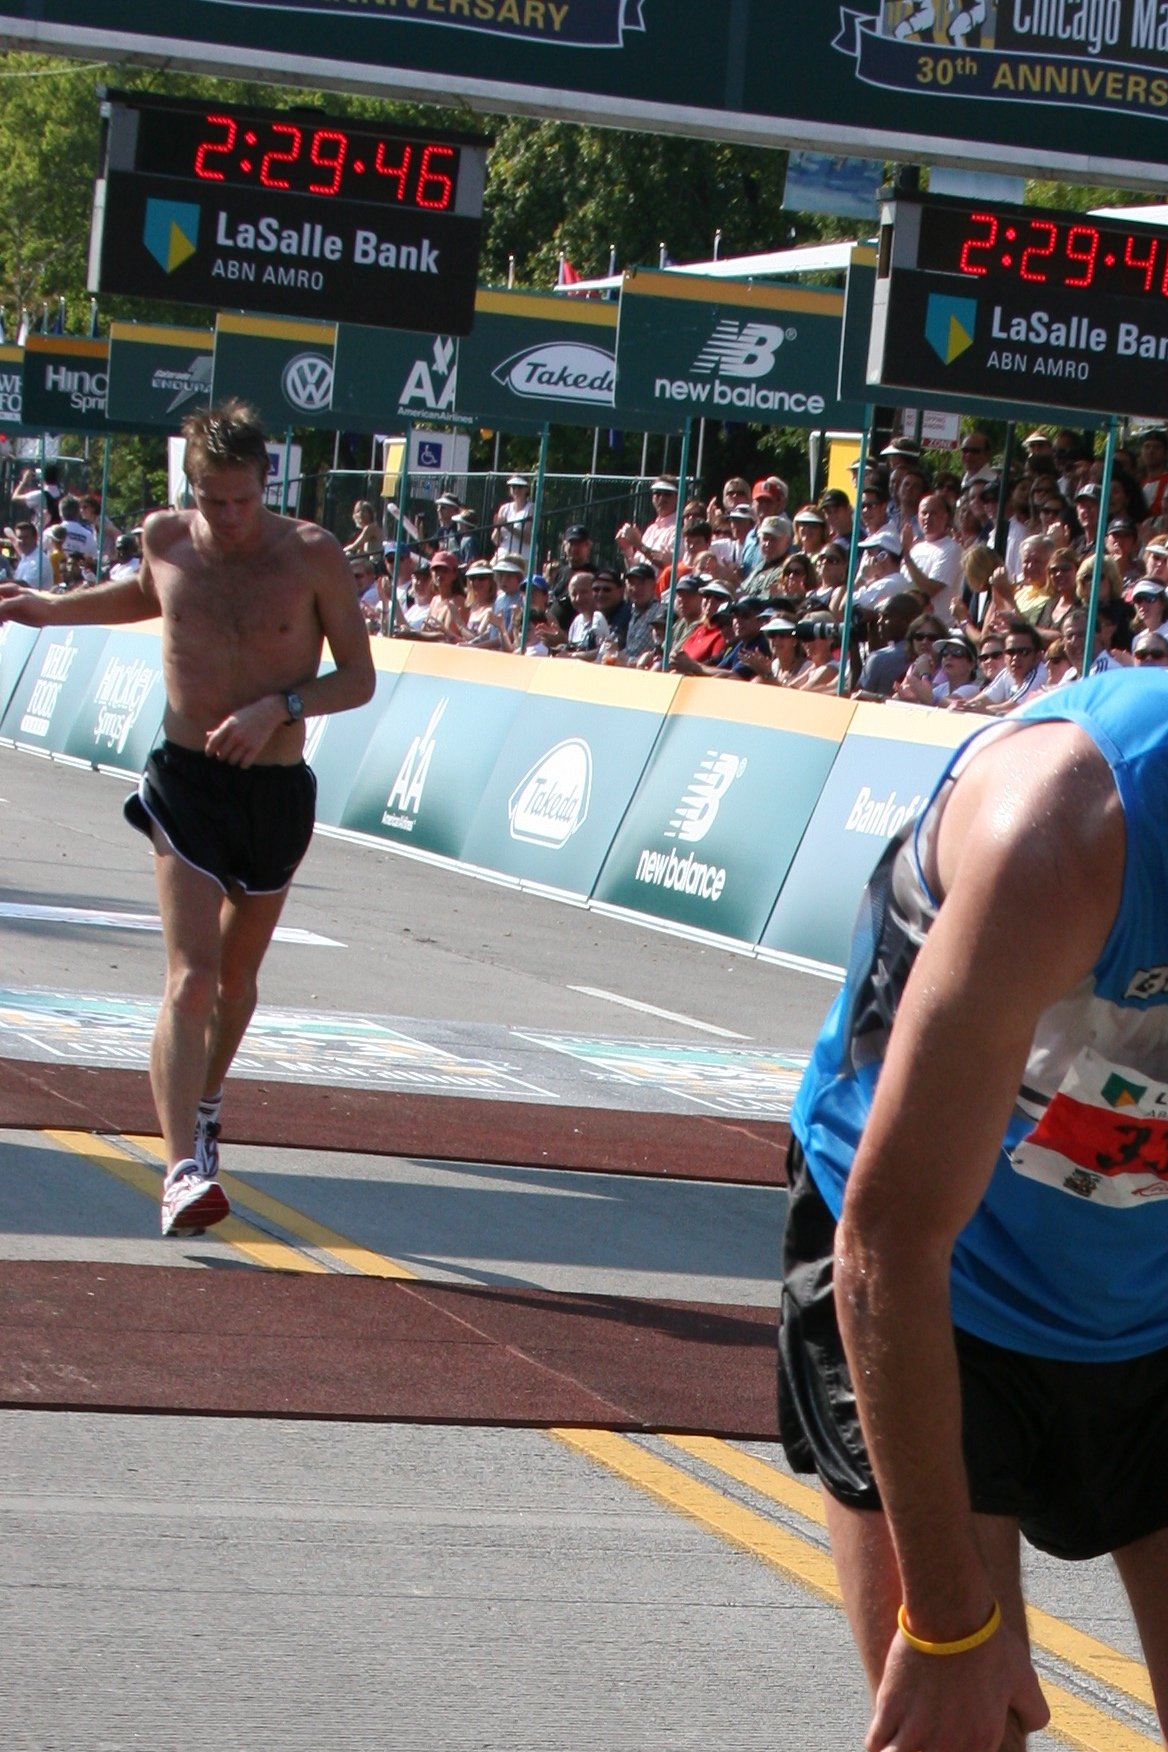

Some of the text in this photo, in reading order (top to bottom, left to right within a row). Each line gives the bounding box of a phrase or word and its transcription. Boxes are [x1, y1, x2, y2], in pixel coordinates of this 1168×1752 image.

[916, 55, 978, 86] 30th
[216, 210, 440, 275] LaSalle Bank
[211, 258, 324, 291] ABN AMRO
[991, 305, 1107, 352] LaSalle
[987, 349, 1090, 382] ABN AMRO
[655, 378, 825, 415] new balance
[523, 776, 580, 824] Takeda
[844, 786, 896, 837] Bank
[634, 847, 727, 902] new balance
